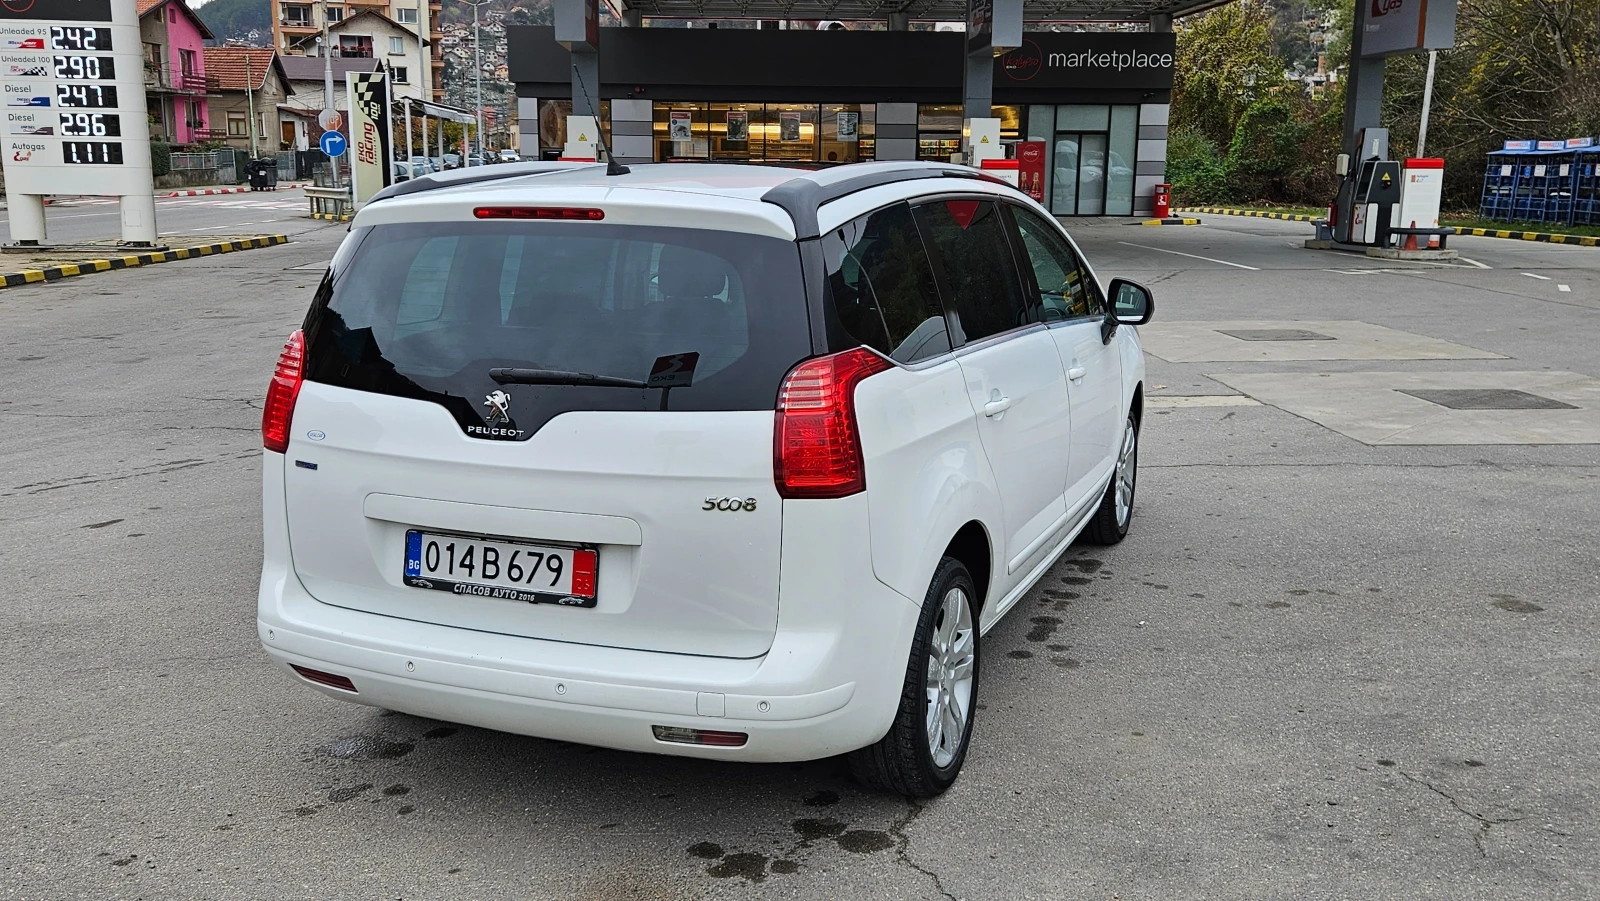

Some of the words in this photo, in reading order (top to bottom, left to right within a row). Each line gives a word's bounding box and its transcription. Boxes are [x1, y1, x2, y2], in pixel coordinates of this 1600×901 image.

[37, 28, 47, 36] 95
[52, 26, 97, 50] 2.42
[1, 55, 36, 63] Unleaded
[55, 56, 101, 79] 2.90
[1049, 49, 1173, 72] marketplace
[5, 84, 31, 93] Diesel
[58, 85, 103, 107] 2.47
[8, 113, 35, 122] Diesel
[370, 102, 379, 120] 100
[61, 113, 107, 136] 2.96
[12, 142, 45, 151] Autogas
[363, 122, 376, 165] racing
[71, 143, 108, 164] 1.11
[467, 425, 524, 437] PEUGEOT
[702, 496, 757, 512] 5008
[408, 559, 420, 570] BG
[453, 583, 491, 597] СПАСОВ
[492, 588, 518, 600] АУТО
[518, 593, 536, 602] 2016
